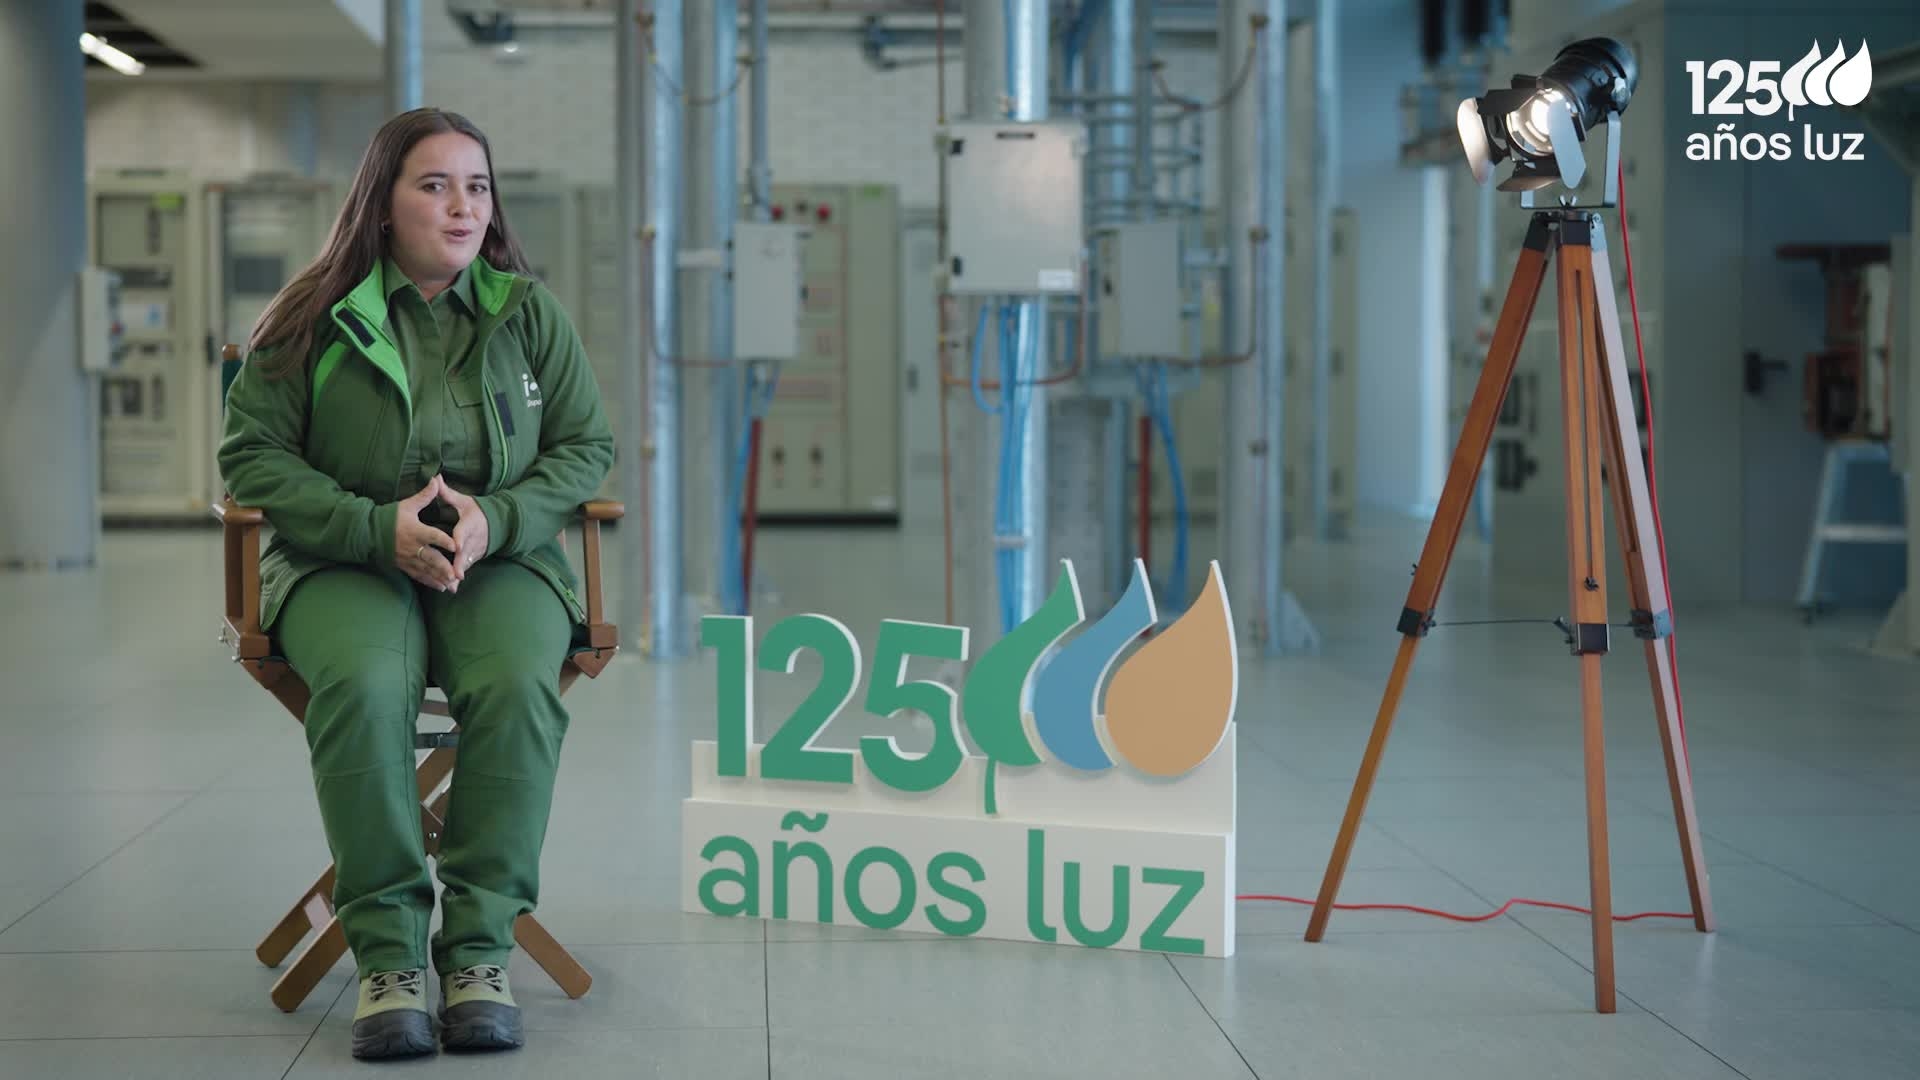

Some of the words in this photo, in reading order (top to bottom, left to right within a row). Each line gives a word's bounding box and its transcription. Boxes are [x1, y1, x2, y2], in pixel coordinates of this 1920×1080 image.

[701, 613, 969, 793] 125
[697, 810, 987, 937] años
[1027, 828, 1206, 956] luz
